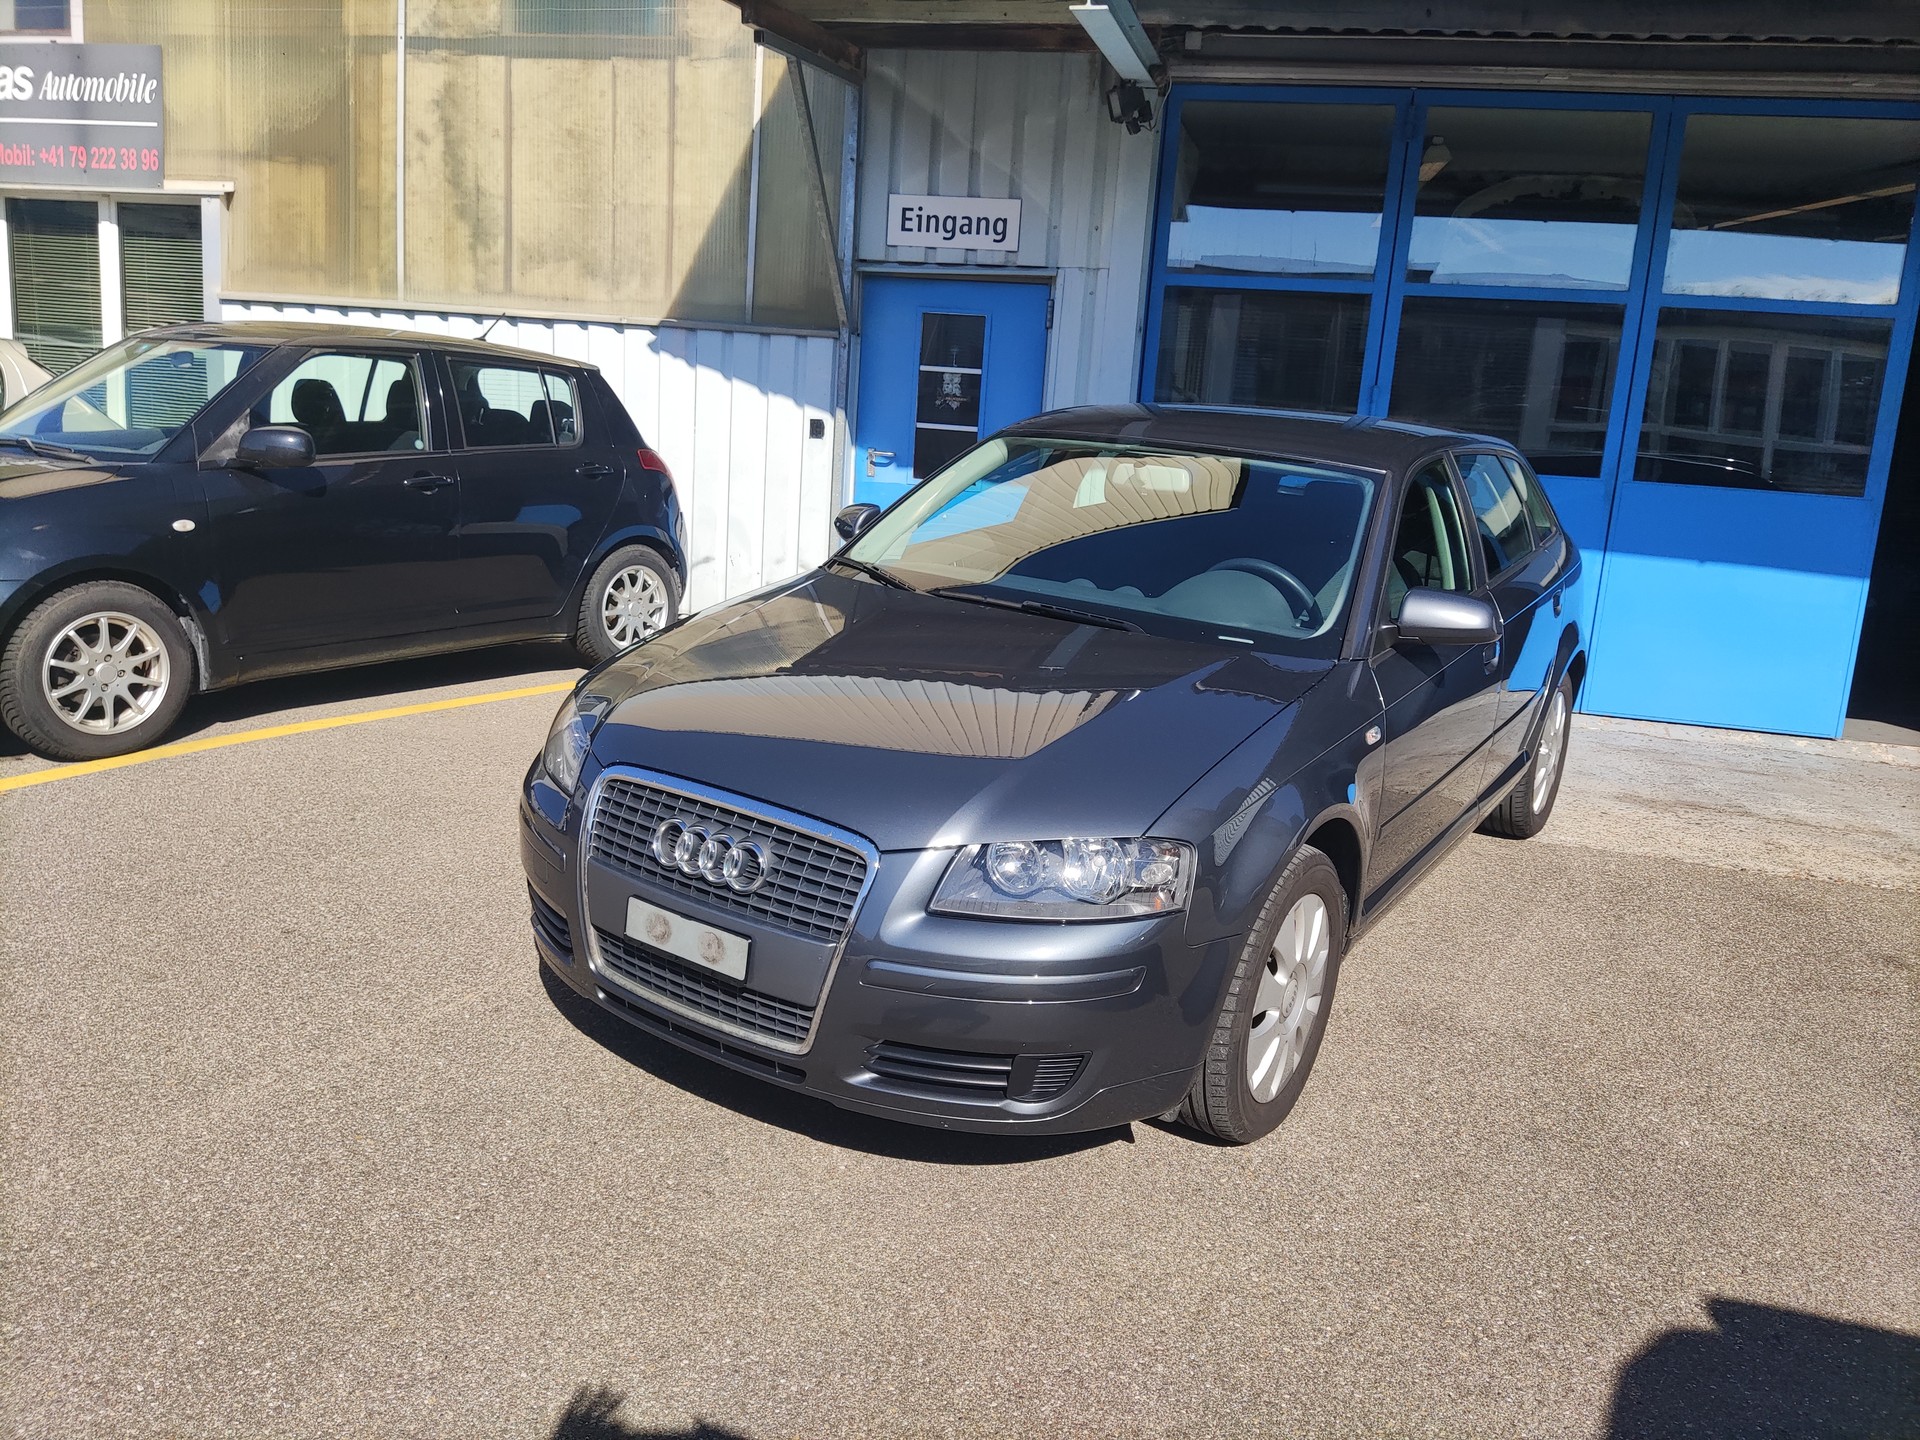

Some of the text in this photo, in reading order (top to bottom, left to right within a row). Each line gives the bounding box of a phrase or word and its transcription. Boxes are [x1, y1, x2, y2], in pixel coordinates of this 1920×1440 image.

[38, 70, 157, 104] Automobile
[39, 144, 64, 168] +41
[69, 145, 87, 169] 79
[90, 146, 116, 170] 222
[120, 147, 138, 170] 38
[141, 148, 159, 171] 96
[900, 206, 1008, 243] Eingang
